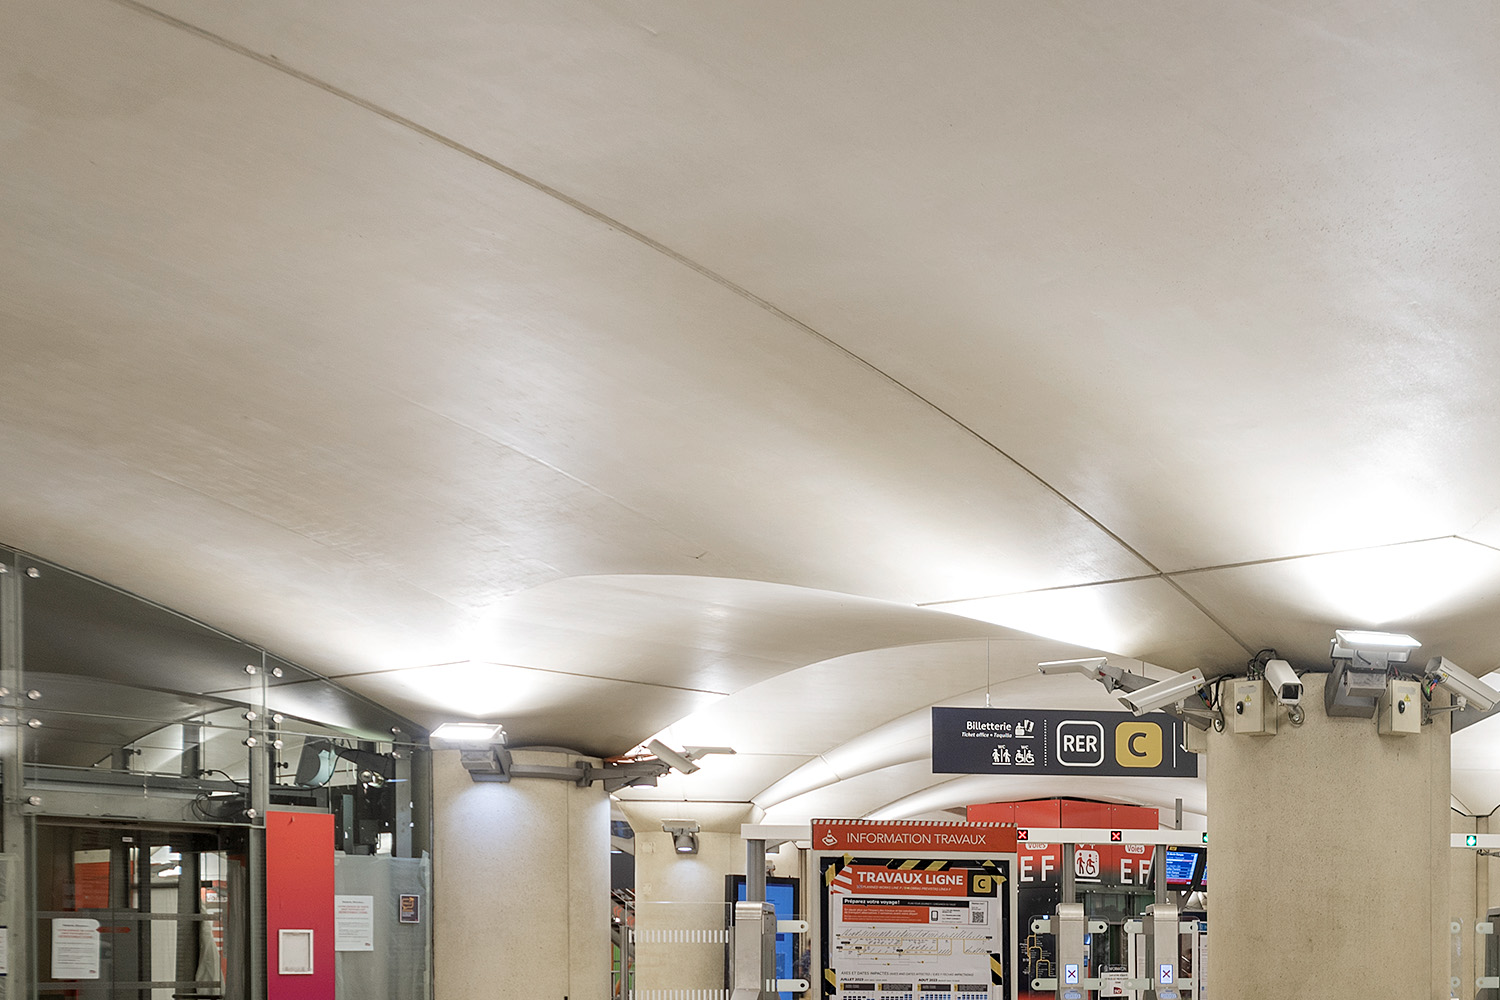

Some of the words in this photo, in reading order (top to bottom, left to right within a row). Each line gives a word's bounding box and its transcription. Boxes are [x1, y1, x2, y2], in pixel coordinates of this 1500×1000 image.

[966, 720, 1012, 731] Billetterie
[1063, 734, 1098, 753] RER
[1127, 732, 1148, 757] C
[846, 832, 932, 844] INFORMATION
[933, 833, 987, 845] TRAVAUX
[1127, 844, 1144, 853] Voies
[1020, 856, 1034, 882] E
[1041, 855, 1055, 882] F
[1120, 858, 1132, 884] E
[1139, 859, 1151, 884] F
[857, 871, 924, 885] TRAVAUX
[925, 874, 964, 885] LIGNE
[977, 878, 986, 889] C
